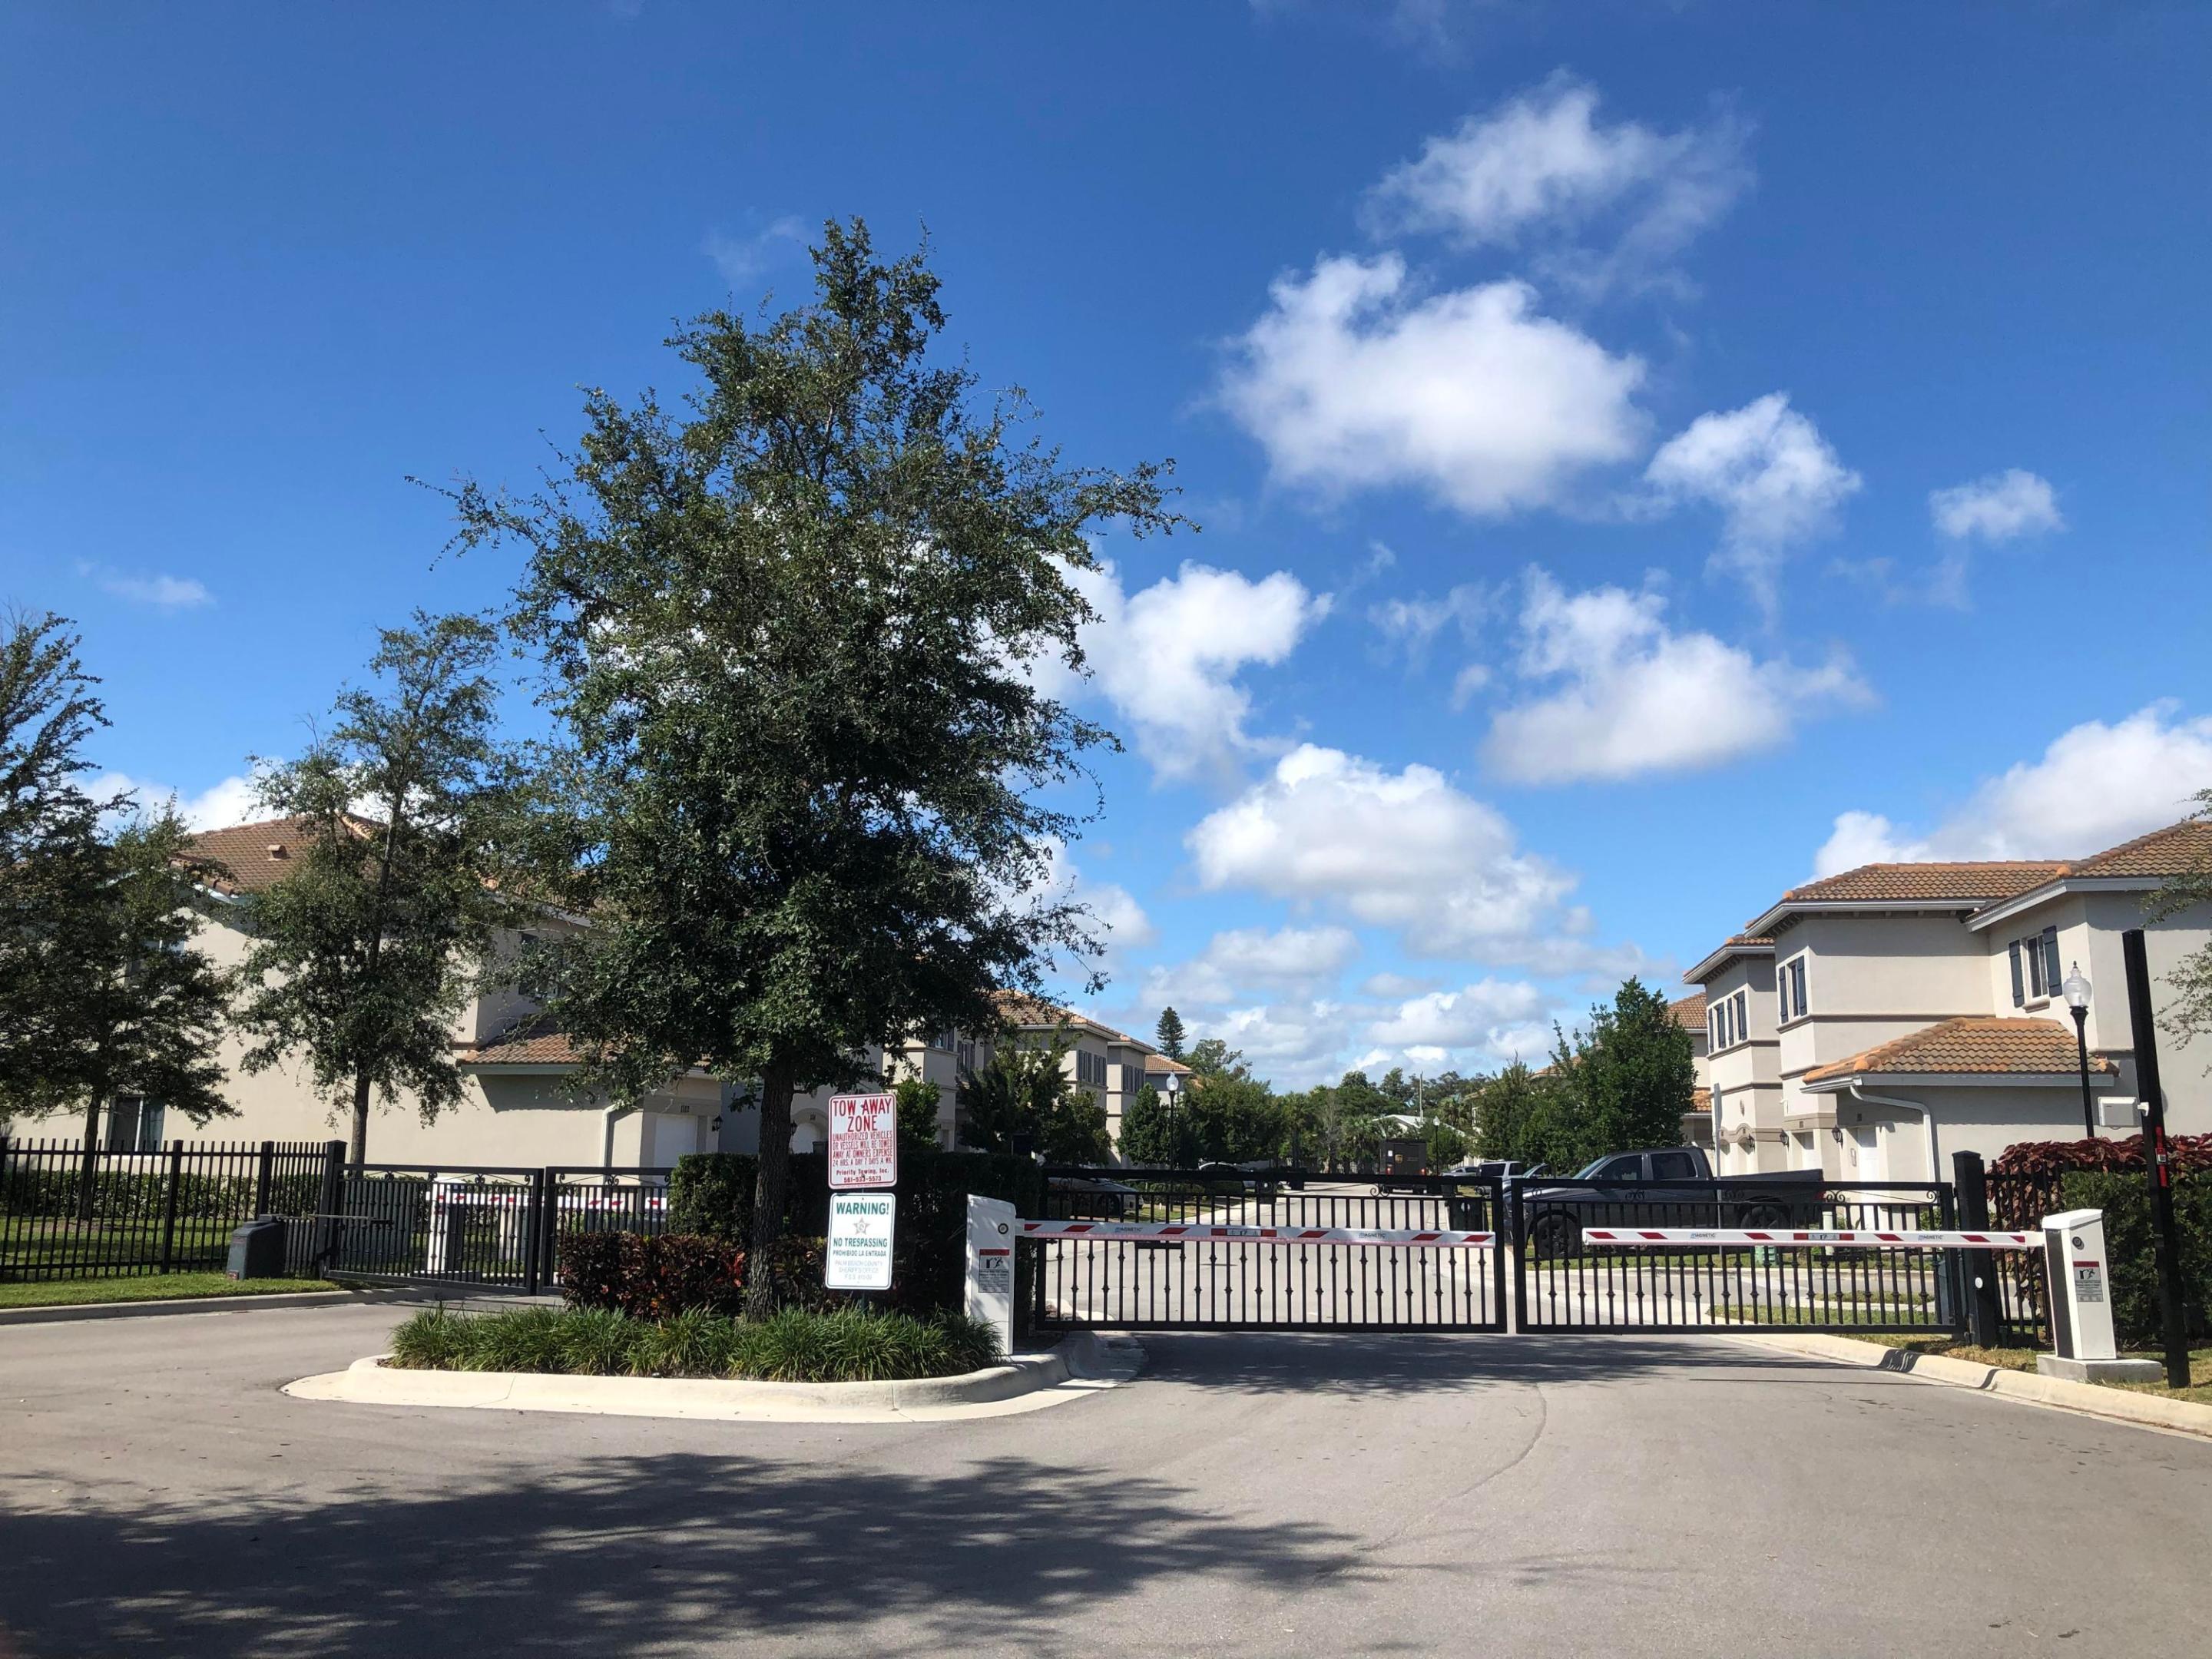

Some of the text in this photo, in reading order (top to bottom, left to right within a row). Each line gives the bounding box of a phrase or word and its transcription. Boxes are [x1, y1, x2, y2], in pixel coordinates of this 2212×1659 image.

[833, 1098, 892, 1117] TOW AWAY
[847, 1114, 878, 1132] ZONE
[833, 1130, 892, 1141] UNAUTHORIZED VEHICLES
[833, 1139, 892, 1151] OR VESSELS WILL BE TOWED
[833, 1150, 844, 1159] AWAY
[846, 1150, 851, 1159] AT
[873, 1147, 892, 1157] EXPENSE
[833, 1158, 839, 1167] 24
[850, 1157, 854, 1166] A
[855, 1157, 863, 1166] DAY
[869, 1157, 879, 1165] DAYS
[880, 1156, 884, 1164] A
[836, 1202, 889, 1215] WARNING!
[833, 1237, 888, 1247] NO TRESPASSING
